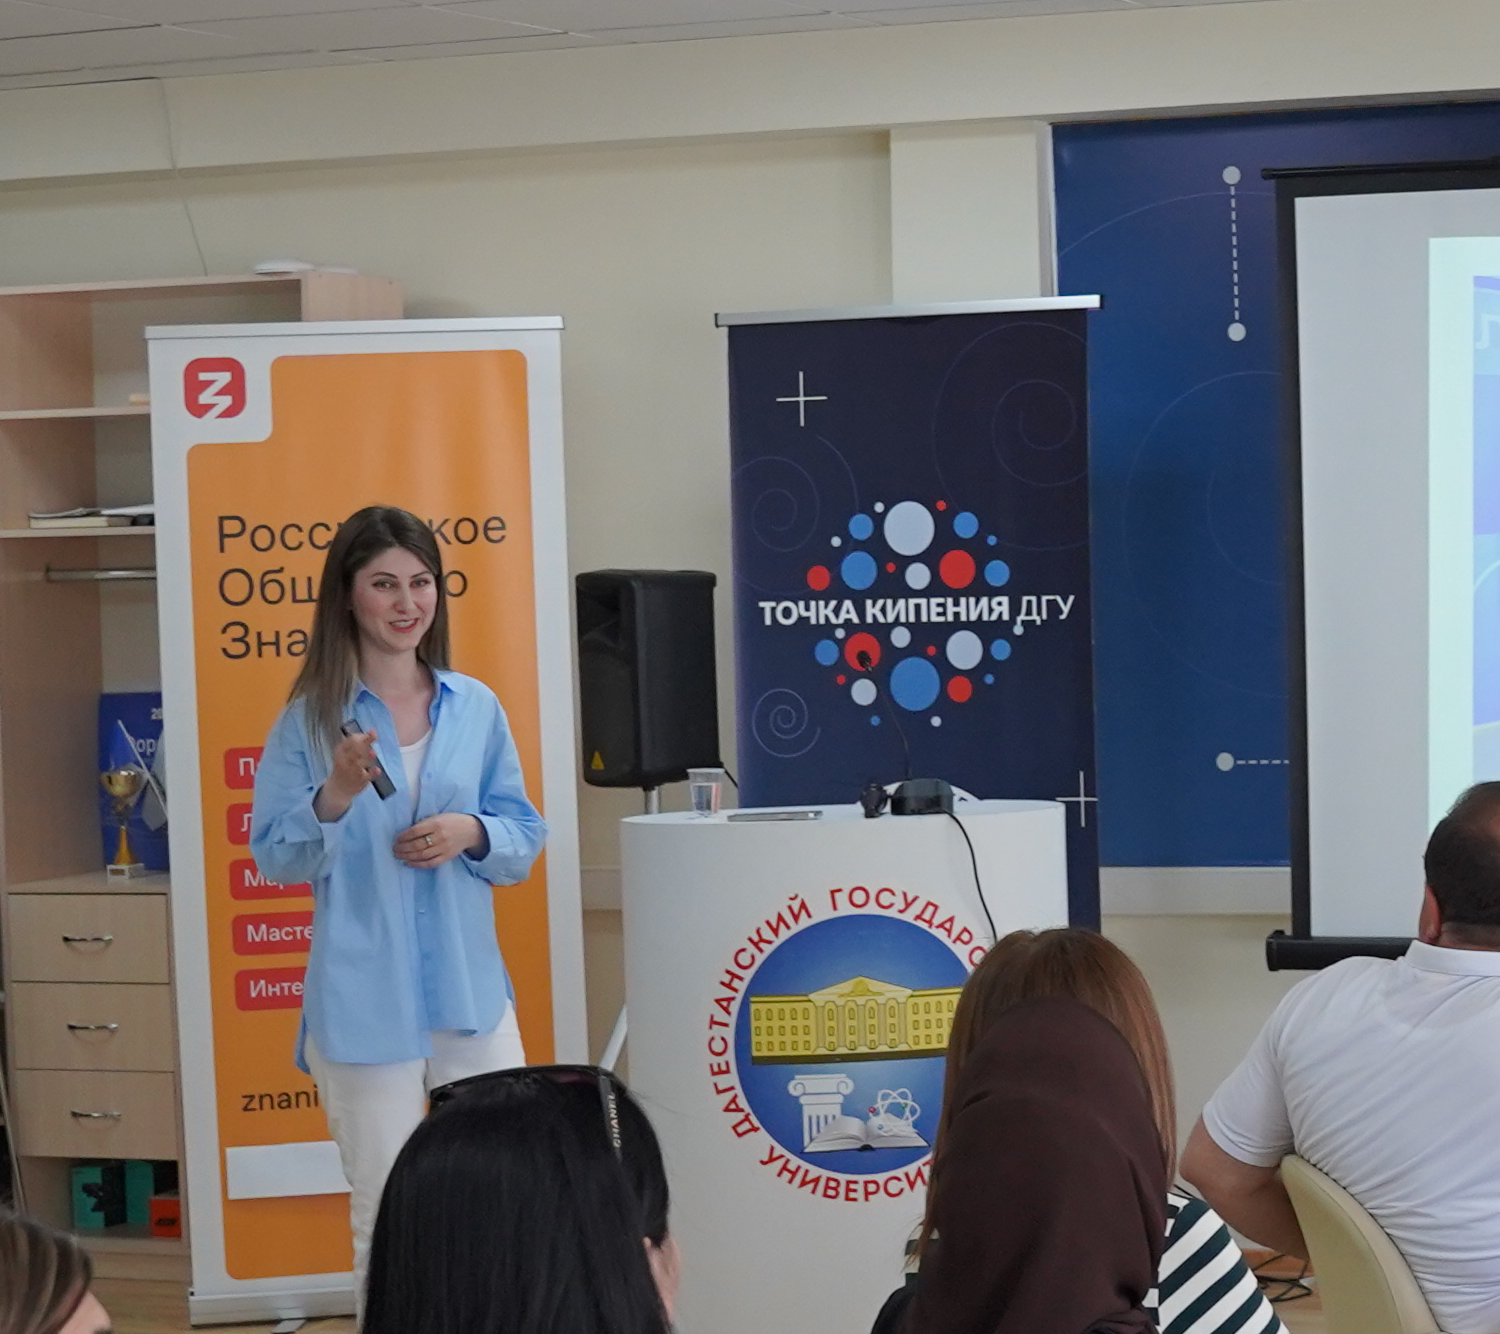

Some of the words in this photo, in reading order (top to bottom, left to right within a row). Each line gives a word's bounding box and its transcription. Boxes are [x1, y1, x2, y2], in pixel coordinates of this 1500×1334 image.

[217, 515, 508, 554] Росское
[218, 566, 468, 606] Общо
[758, 599, 860, 626] ТОЧКА
[864, 596, 1010, 624] КИПЕНИЯ
[1016, 594, 1076, 626] ДГУ
[220, 620, 308, 659] Зна
[707, 893, 814, 1139] ДАГЕСТАНСКИЙ
[828, 885, 988, 968] ГОСУДАРС
[759, 1144, 935, 1203] УНИВЕРСИ
